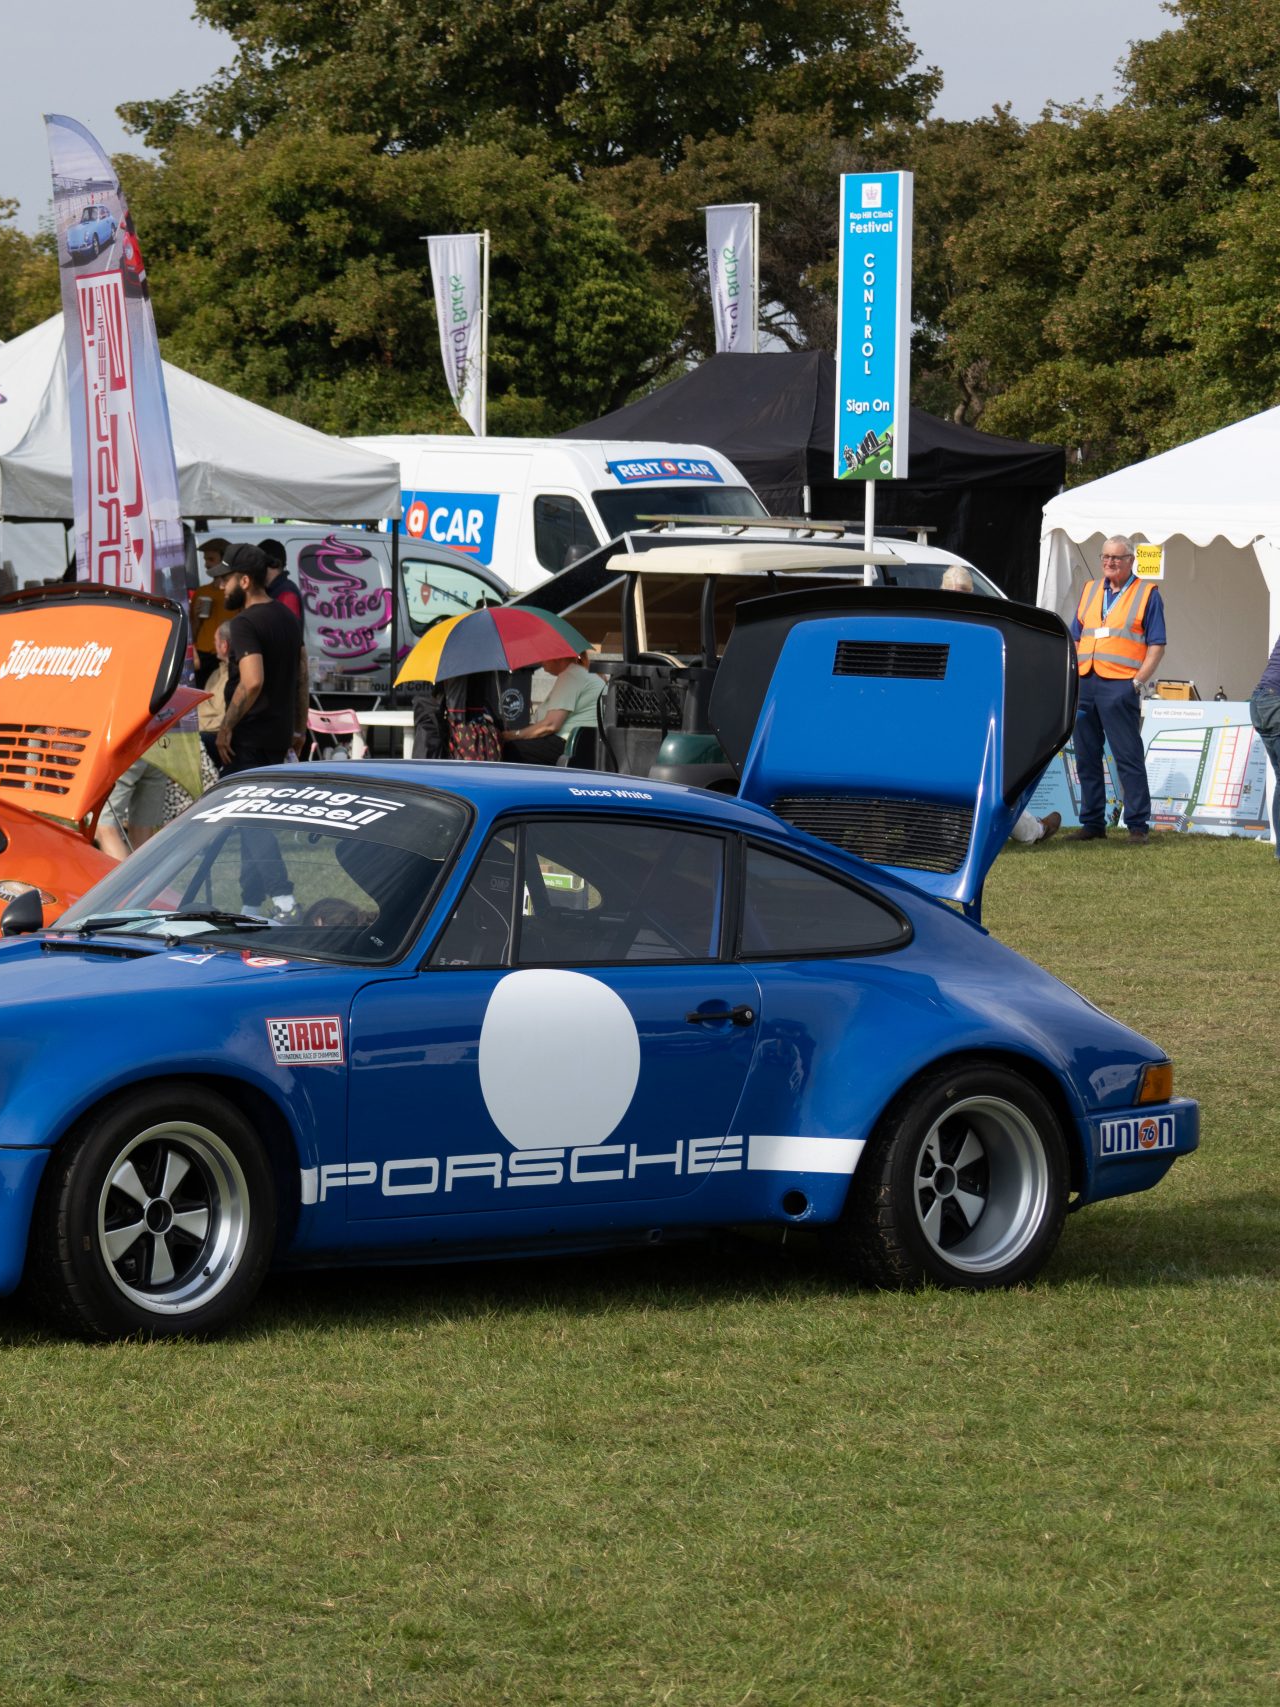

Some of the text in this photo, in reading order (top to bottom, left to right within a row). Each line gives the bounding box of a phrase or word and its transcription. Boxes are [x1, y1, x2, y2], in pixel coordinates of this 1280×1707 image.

[862, 211, 872, 219] Hill
[873, 210, 893, 219] Climb
[849, 221, 893, 233] Festival
[863, 253, 875, 375] CONTROL
[846, 399, 890, 415] Sign On
[616, 461, 714, 478] RENT a CAR
[408, 512, 424, 533] a
[429, 507, 484, 544] CAR
[1136, 549, 1162, 558] Steward
[1137, 564, 1161, 574] Control
[303, 592, 383, 620] Coffee
[223, 785, 363, 807] Racing
[568, 787, 653, 801] Bruce White
[287, 1021, 339, 1052] IROC
[1140, 1124, 1159, 1144] 76
[319, 1135, 743, 1203] PORSCHE
